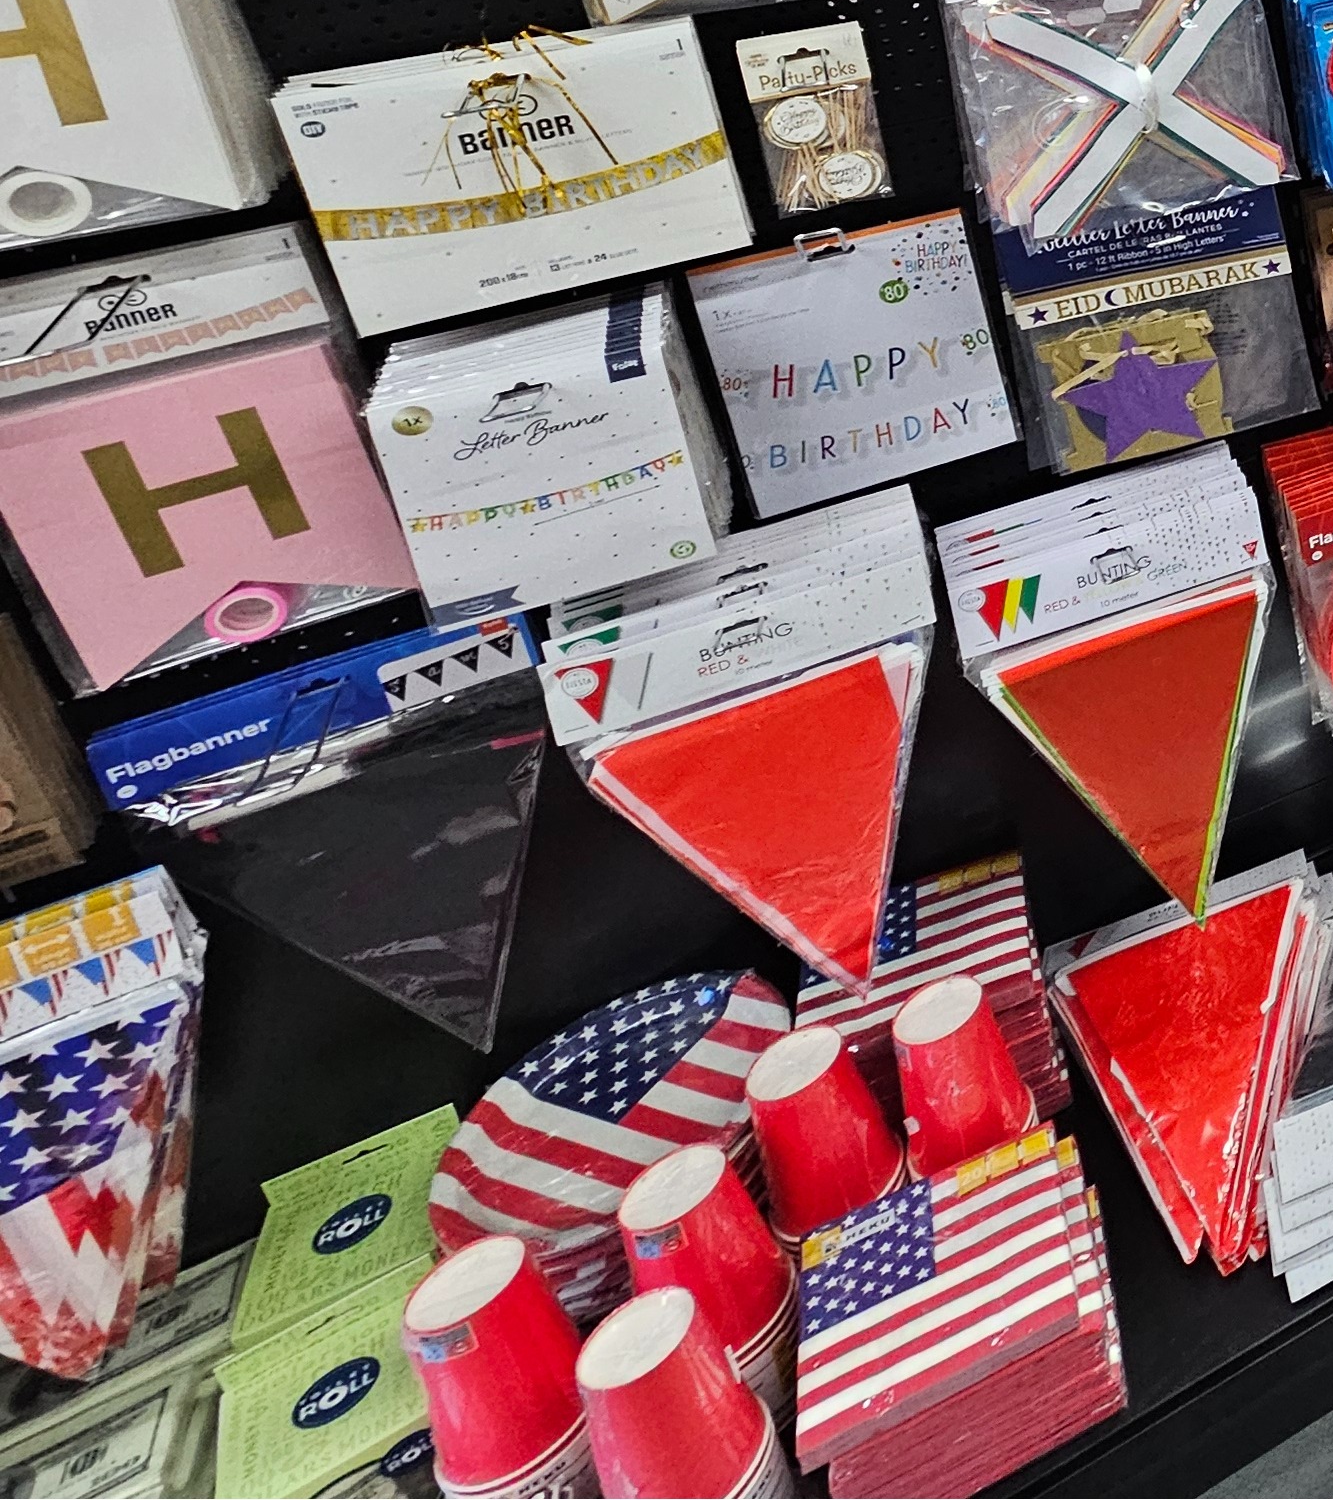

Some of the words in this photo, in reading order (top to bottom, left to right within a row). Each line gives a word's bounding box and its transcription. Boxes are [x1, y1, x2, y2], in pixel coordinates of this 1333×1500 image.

[347, 202, 498, 239] HAPPY
[1172, 205, 1243, 229] Banner
[904, 254, 967, 273] BIRTHDAY!
[917, 242, 957, 257] HAPPY
[1067, 247, 1107, 259] CARTEL
[1110, 242, 1124, 251] DE
[1117, 248, 1149, 262] Ribbon
[1174, 239, 1194, 254] High
[884, 282, 905, 301] 80
[1056, 292, 1101, 320] EID
[1125, 261, 1261, 305] MUBARAK
[772, 336, 940, 399] HAPPY
[453, 431, 522, 461] Letter
[524, 411, 610, 446] Banner
[769, 398, 970, 469] BIRTHDAY
[81, 406, 311, 578] H
[1043, 598, 1069, 615] RED
[697, 658, 731, 679] RED
[105, 717, 272, 784] Flagbanner
[316, 1208, 386, 1248] ROLL
[298, 1370, 378, 1423] ROLL
